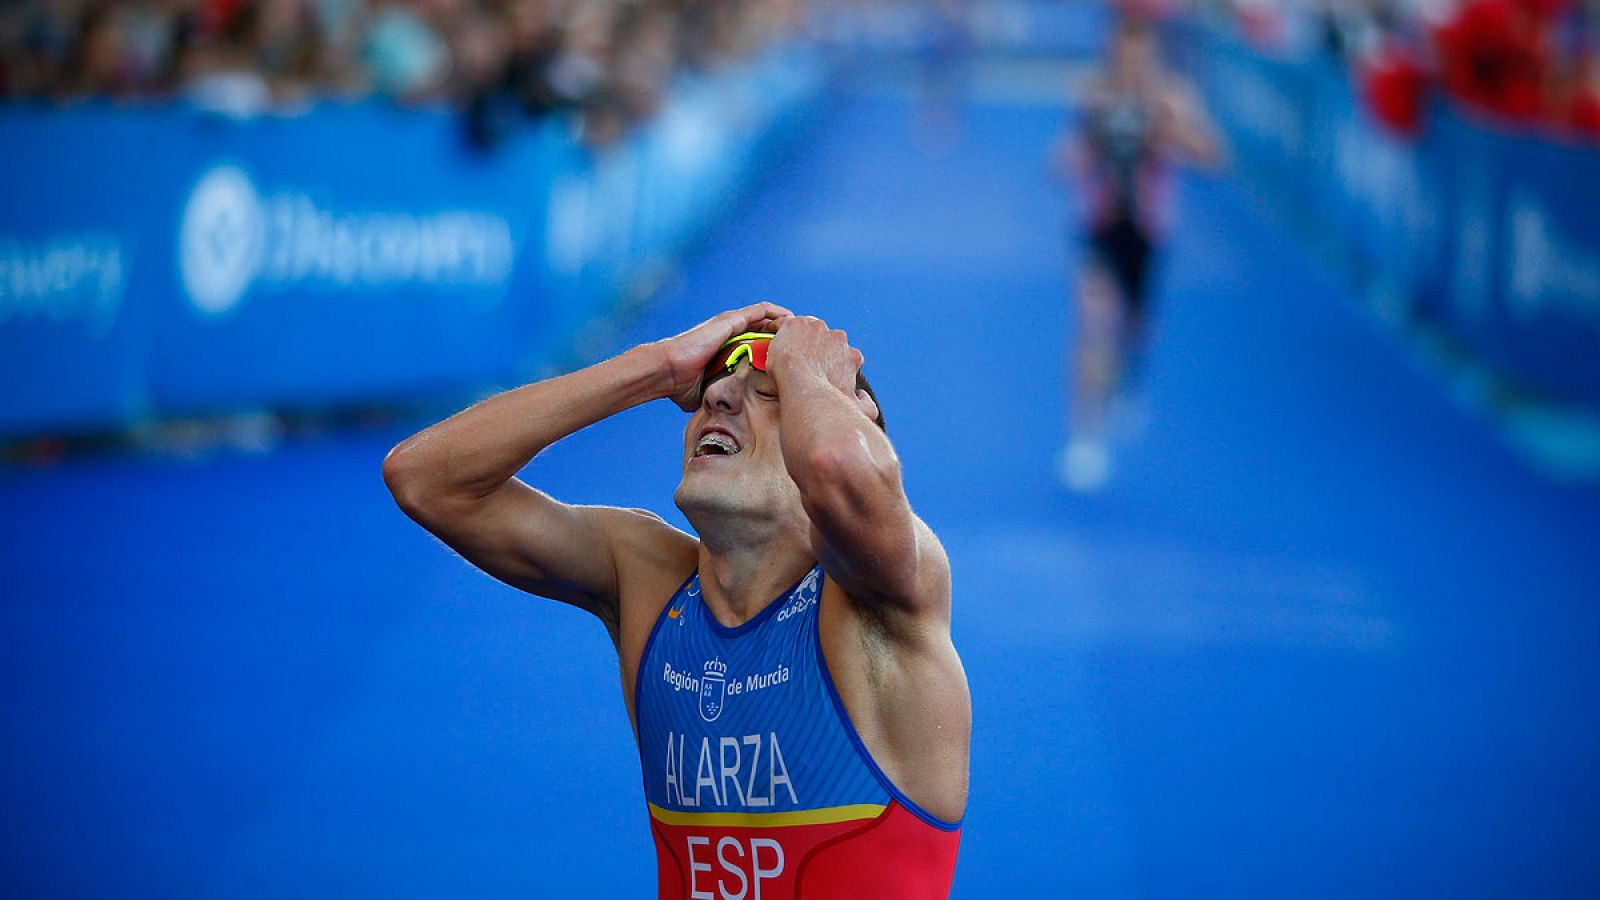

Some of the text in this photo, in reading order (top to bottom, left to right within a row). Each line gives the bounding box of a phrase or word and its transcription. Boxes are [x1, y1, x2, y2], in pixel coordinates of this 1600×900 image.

[663, 662, 789, 696] Región de Murcia
[666, 731, 799, 806] ALARZA
[687, 835, 785, 900] ESP
